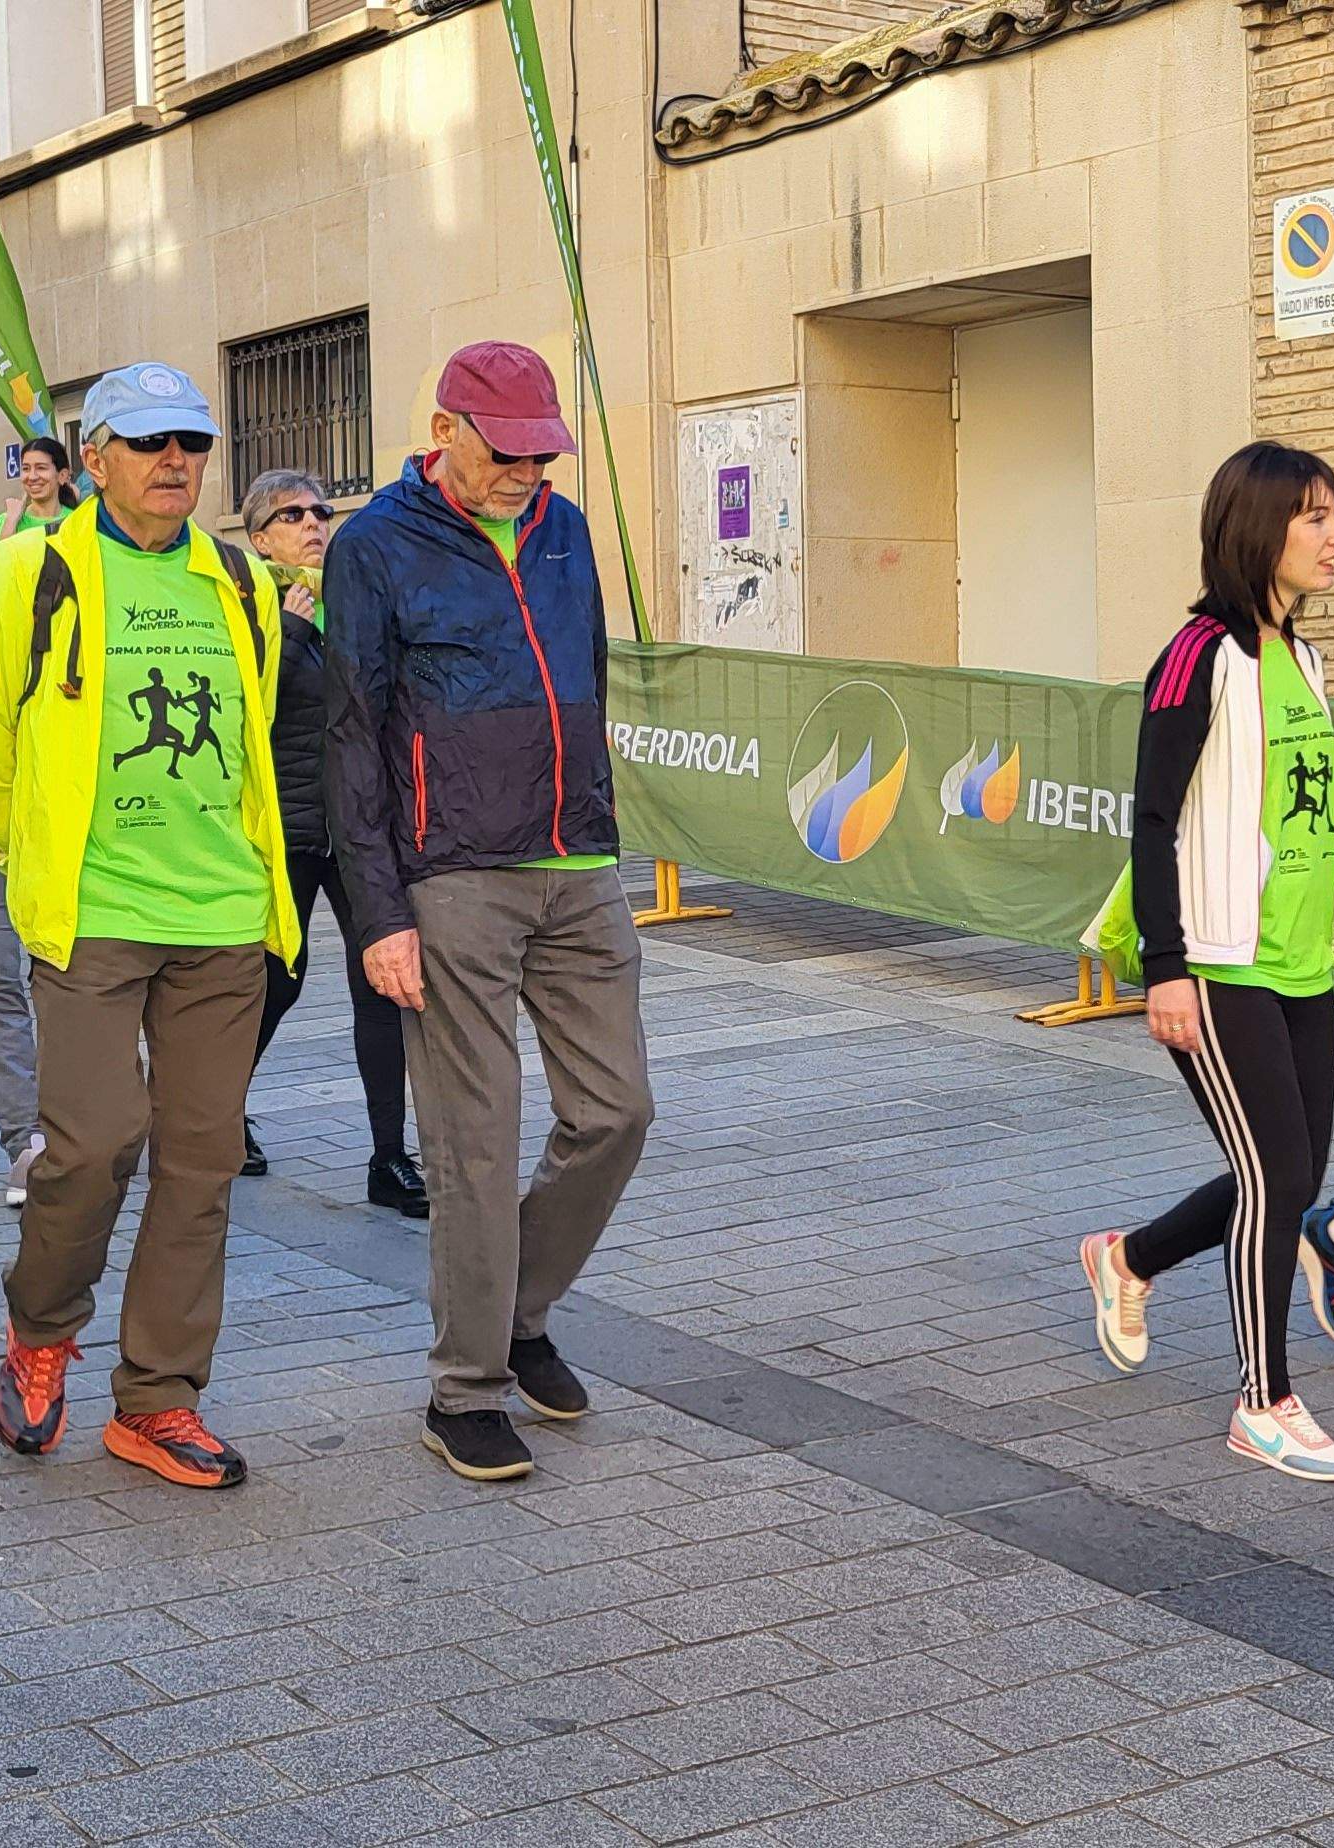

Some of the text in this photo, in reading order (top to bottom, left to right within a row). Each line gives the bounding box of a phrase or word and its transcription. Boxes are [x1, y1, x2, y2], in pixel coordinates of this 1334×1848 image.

[1279, 299, 1302, 315] VADO
[132, 620, 184, 632] UNIVERSO
[106, 646, 143, 655] ORMA
[146, 646, 171, 655] POR
[175, 646, 190, 655] LA
